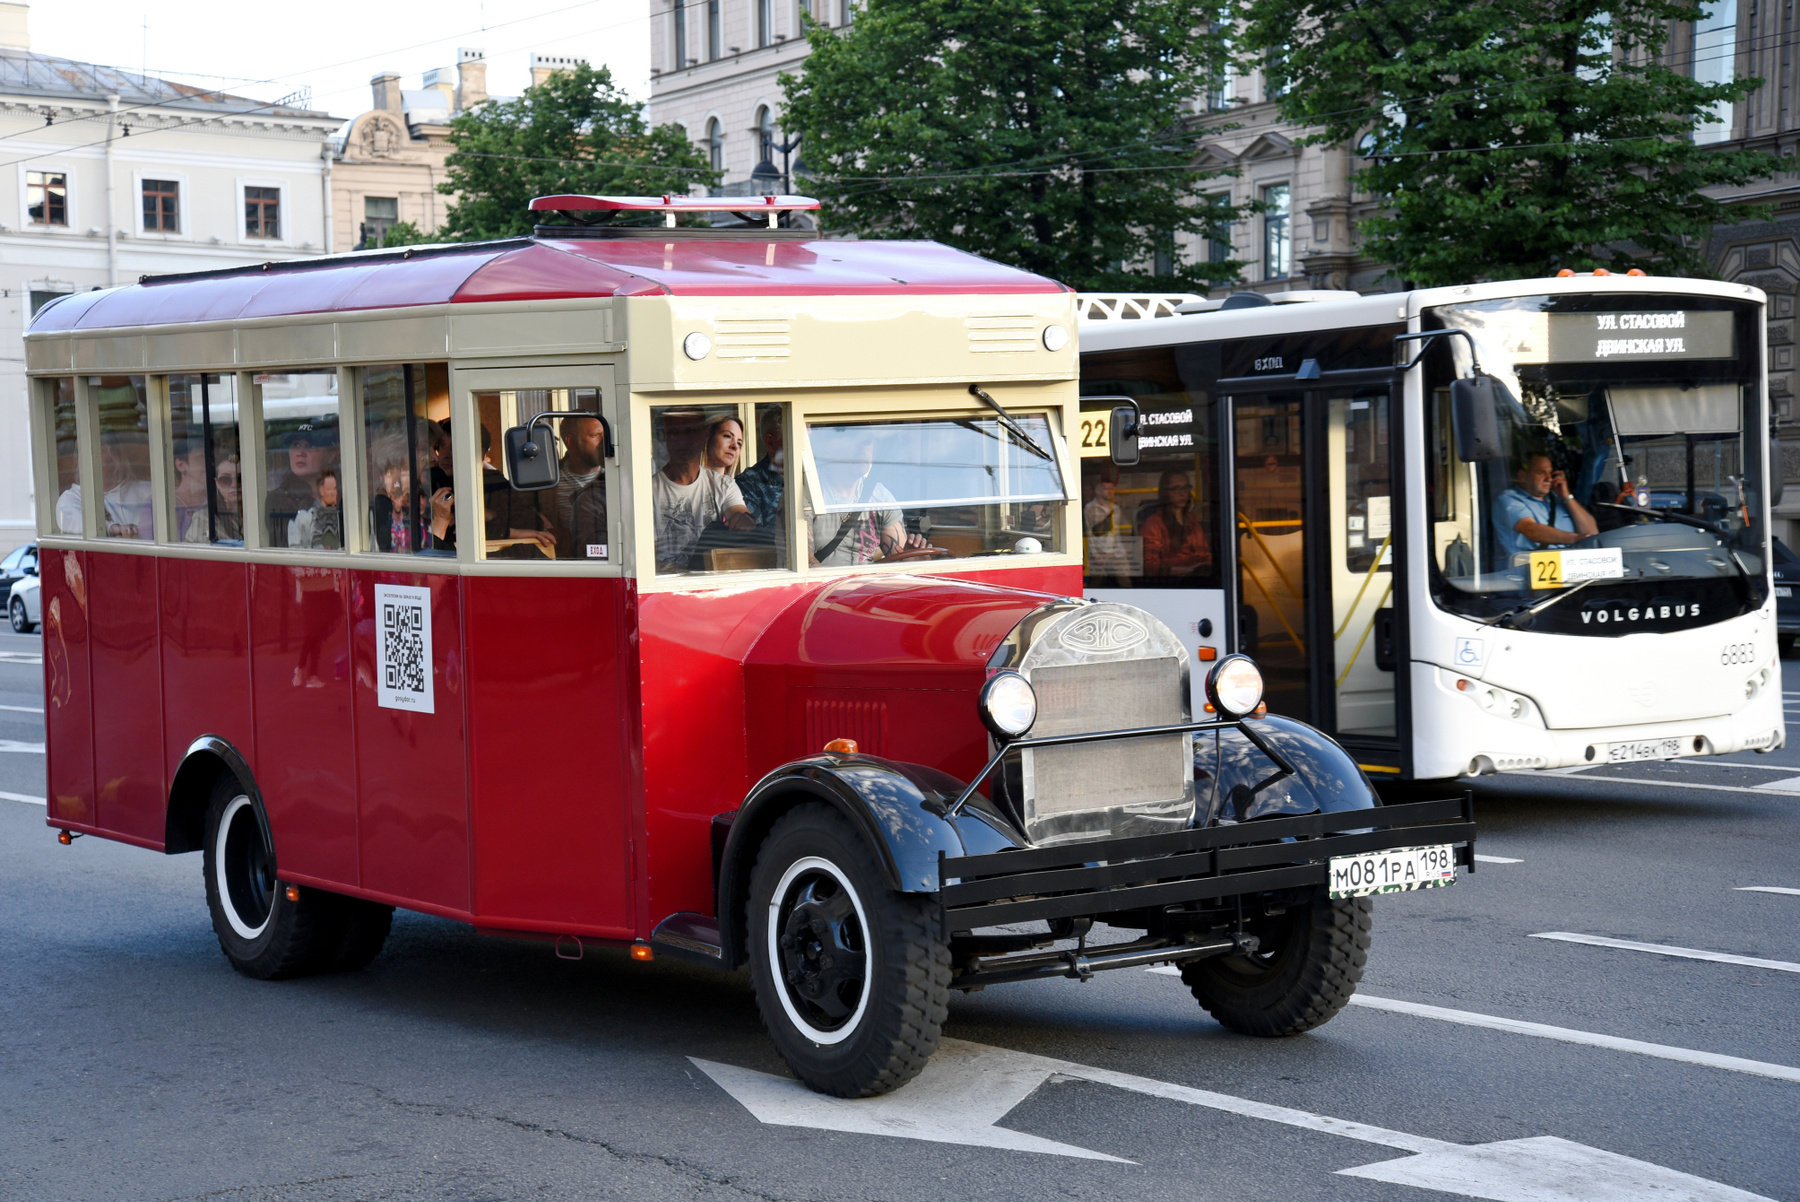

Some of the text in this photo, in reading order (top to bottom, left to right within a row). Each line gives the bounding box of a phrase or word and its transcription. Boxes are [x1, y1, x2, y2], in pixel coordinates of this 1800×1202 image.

[1597, 311, 1685, 330] УЛ. СТАСОВОЙ
[1596, 338, 1686, 357] ДВИНСКАЯ УЛ.
[1254, 356, 1283, 370] ВХОД
[1148, 409, 1193, 425] СТАСОВОЙ
[1081, 419, 1107, 447] 22
[1179, 434, 1194, 446] УЛ.
[1537, 560, 1557, 581] 22
[1581, 603, 1700, 624] VOLGABUS
[1064, 618, 1144, 648] ЗИС
[1720, 642, 1755, 666] 6883
[1336, 849, 1449, 888] М081РА 198
[1426, 870, 1440, 878] RUS
